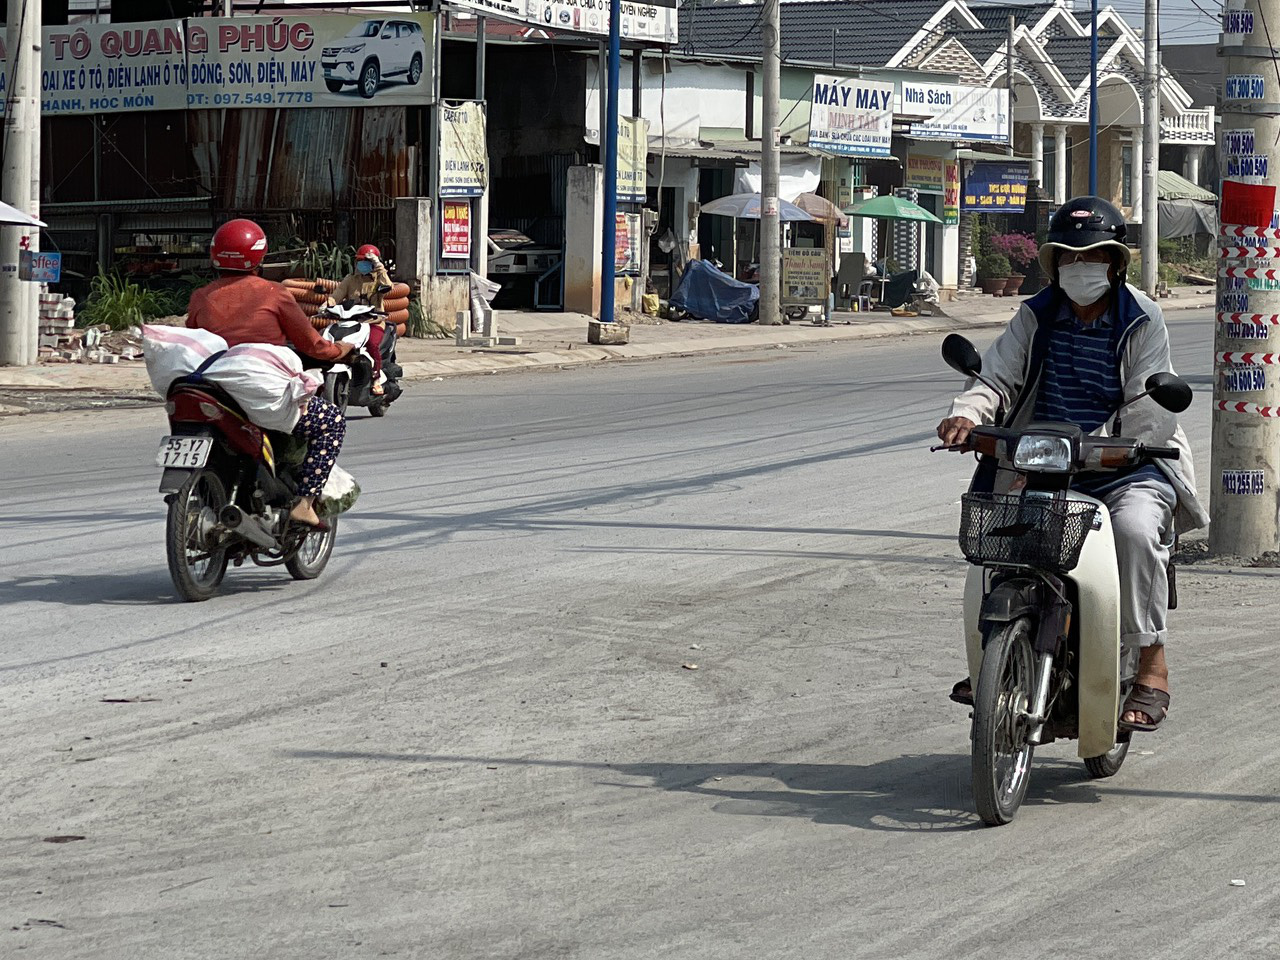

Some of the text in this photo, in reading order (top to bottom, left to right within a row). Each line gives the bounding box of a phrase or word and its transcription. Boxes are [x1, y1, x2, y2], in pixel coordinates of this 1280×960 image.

[50, 17, 314, 60] TÔ QUANG PHÚC
[41, 69, 60, 97] OẠI
[62, 70, 75, 91] XE
[79, 65, 86, 89] Ô
[107, 63, 131, 94] ĐIỆN
[134, 63, 161, 93] LẠNH
[163, 60, 171, 85] Ô
[291, 54, 316, 82] MÁY
[41, 98, 85, 113] HẠNH,
[123, 92, 154, 107] MÔN
[213, 92, 313, 105] 097.549.7778
[815, 79, 891, 110] MÁY MAY
[905, 87, 951, 105] Nhà Sách
[829, 111, 855, 129] MINH
[32, 256, 58, 268] offee
[167, 439, 204, 452] 55-Y7
[163, 452, 200, 465] 1715
